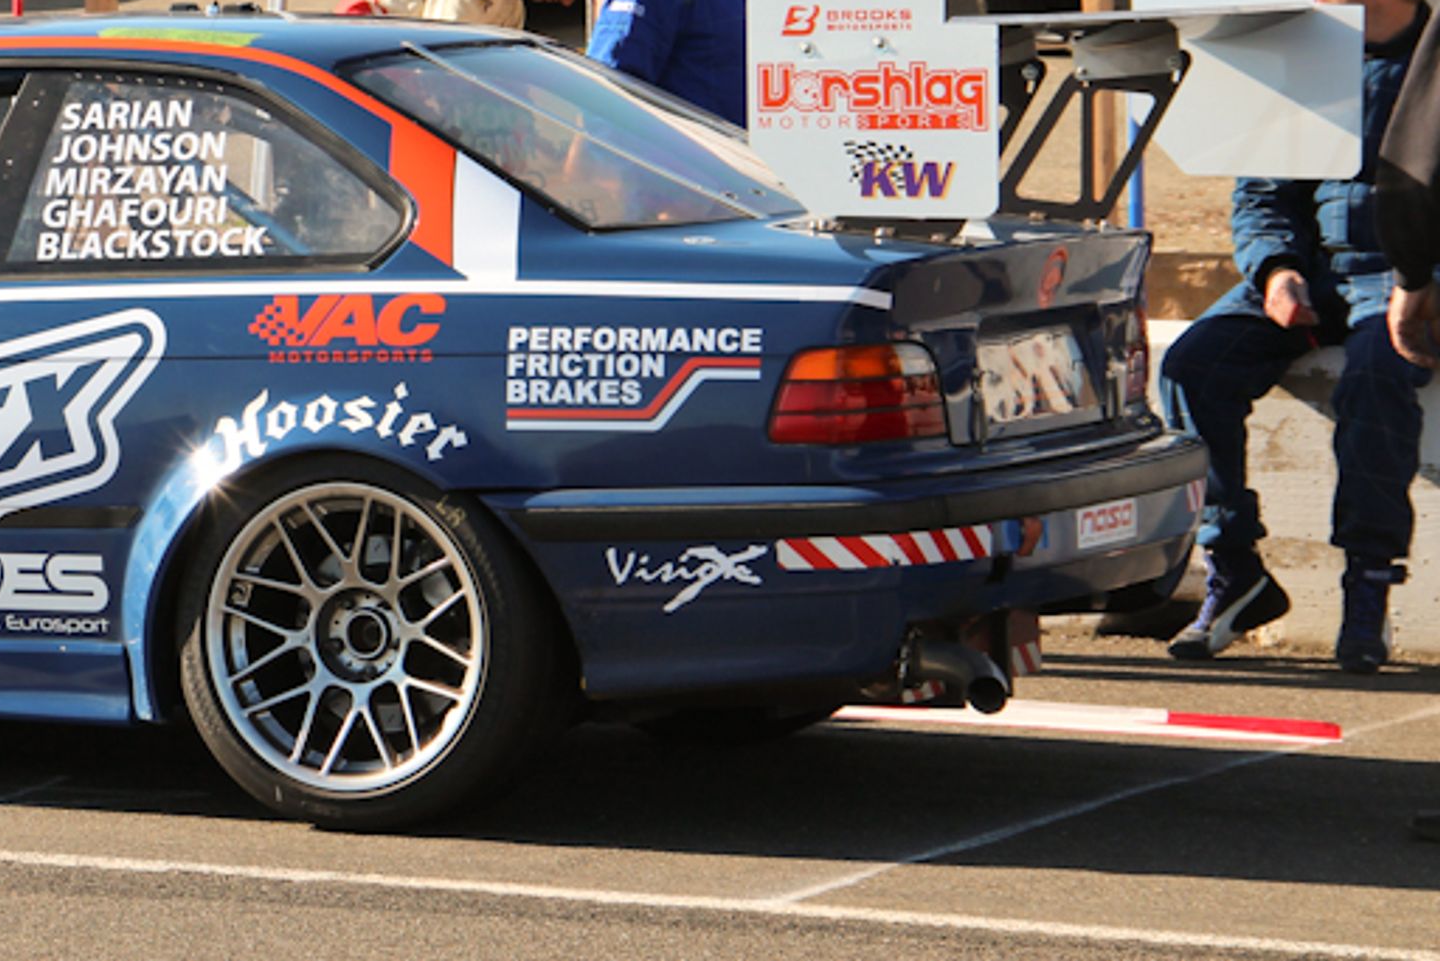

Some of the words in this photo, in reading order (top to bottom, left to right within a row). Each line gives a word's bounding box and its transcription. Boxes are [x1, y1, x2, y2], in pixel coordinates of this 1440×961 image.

[827, 10, 912, 21] BROOKS
[61, 100, 193, 131] SARIAN
[52, 132, 227, 164] JOHNSON
[44, 165, 228, 197] MIRZAYAN
[861, 161, 956, 200] KW
[42, 196, 229, 229] GHAFOURI
[36, 226, 268, 261] BLACKSTOCK
[248, 293, 447, 347] VAC
[508, 327, 763, 352] PERFORMANCE
[268, 350, 434, 363] MOTORSPORTS
[507, 354, 665, 377] FRICTION
[506, 379, 643, 404] BRAKES
[208, 382, 468, 478] Hoosier
[5, 615, 110, 634] Eurosport
